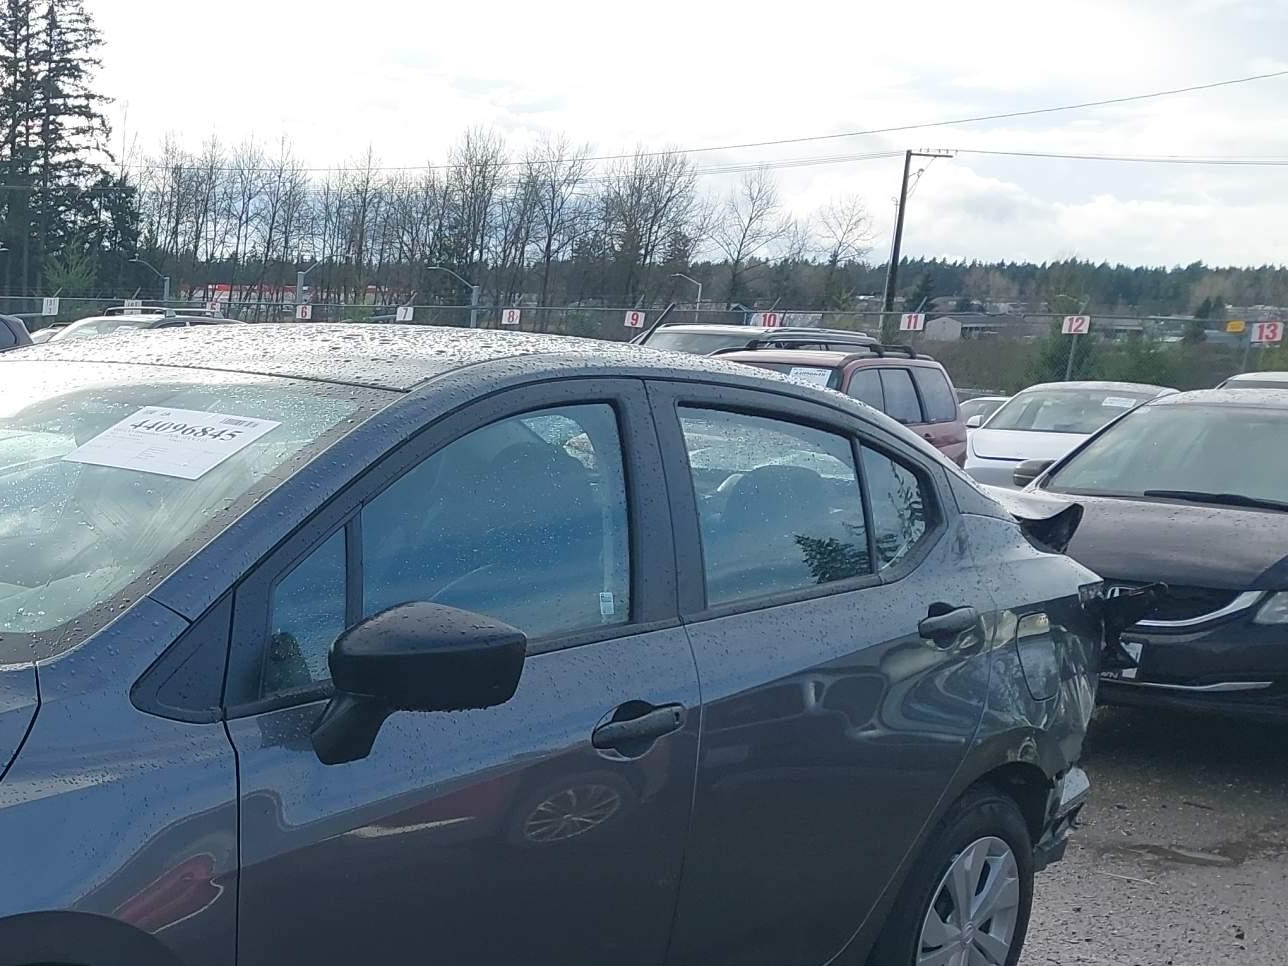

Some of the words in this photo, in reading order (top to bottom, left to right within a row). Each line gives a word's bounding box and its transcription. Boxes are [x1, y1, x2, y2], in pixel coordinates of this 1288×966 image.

[300, 305, 307, 318] 6
[402, 307, 409, 320] 7
[630, 312, 640, 326] 9
[762, 313, 777, 328] 10
[905, 314, 919, 330] 11
[1067, 316, 1085, 333] 12
[1257, 323, 1278, 341] 13
[129, 418, 245, 442] 44096845
